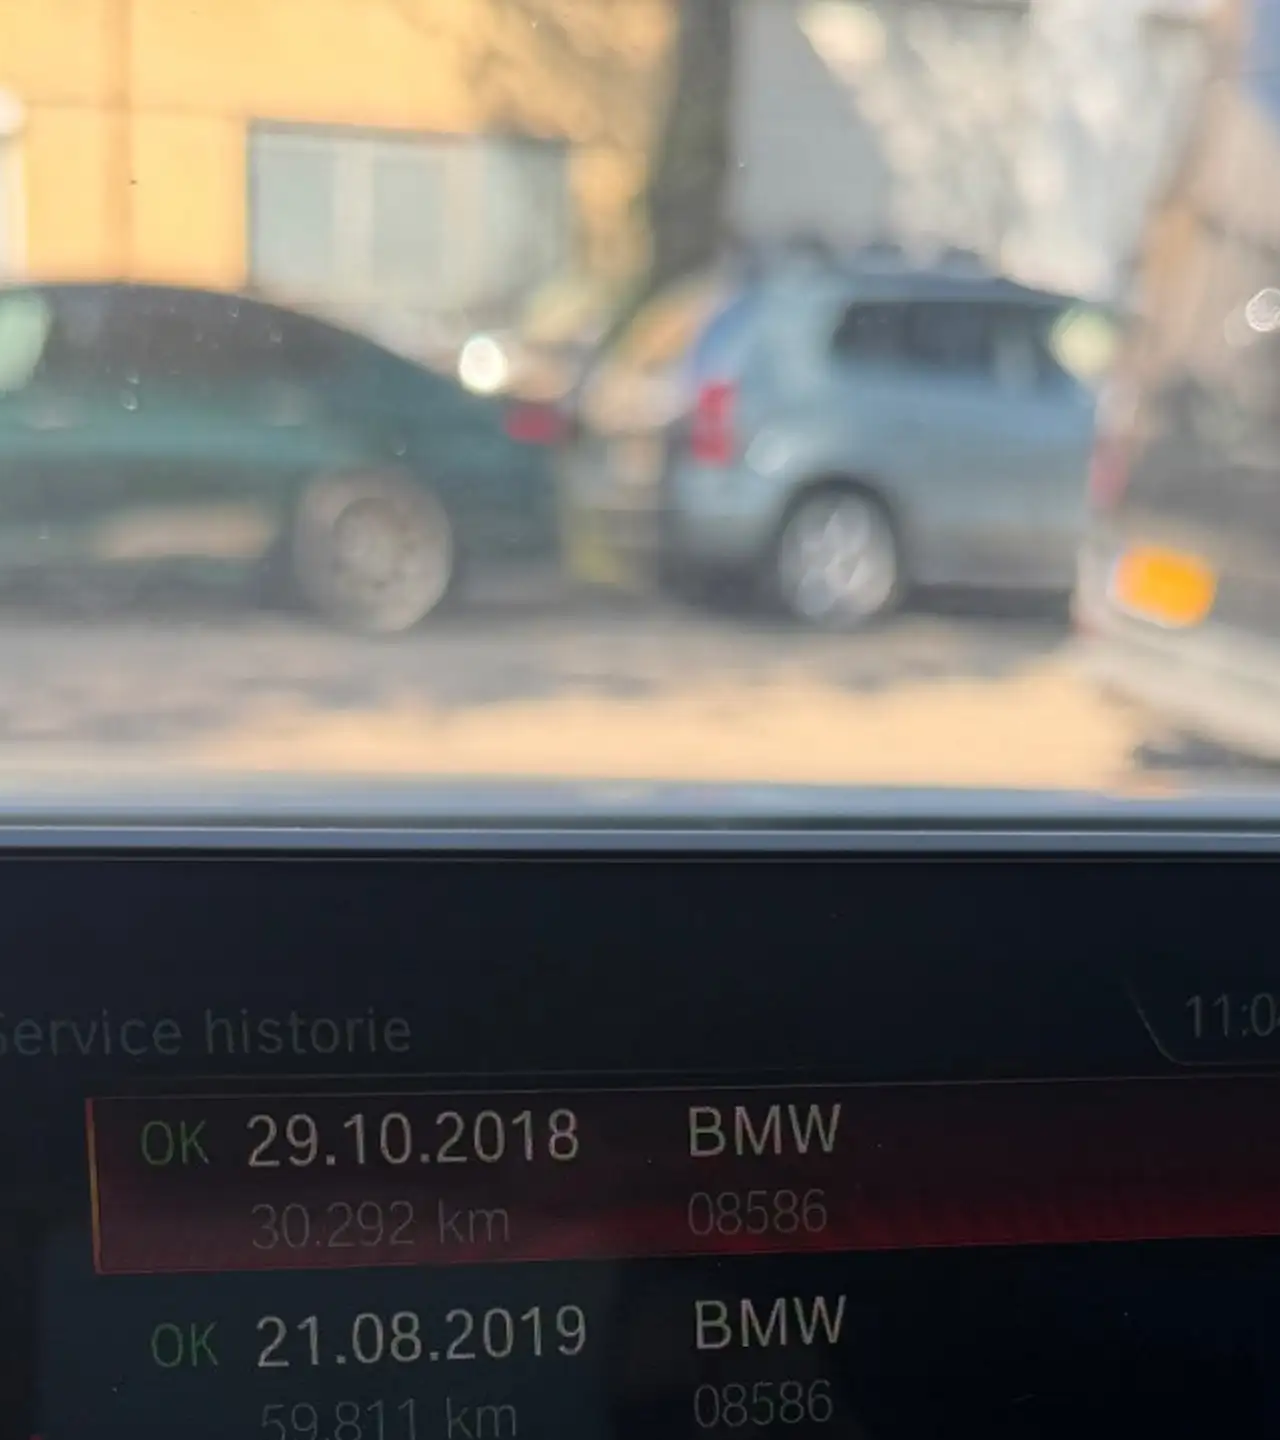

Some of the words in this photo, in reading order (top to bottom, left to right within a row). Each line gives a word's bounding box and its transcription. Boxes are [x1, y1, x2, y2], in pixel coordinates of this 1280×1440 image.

[204, 1005, 412, 1054] historie
[140, 1118, 211, 1167] OK
[245, 1107, 580, 1168] 29.10.2018
[687, 1102, 842, 1159] BMW
[250, 1199, 415, 1250] 30.292
[436, 1197, 511, 1245] km
[686, 1187, 828, 1237] 08586
[149, 1319, 220, 1368] OK
[255, 1303, 587, 1369] 21.08.2019
[693, 1293, 847, 1350] BMW
[444, 1395, 518, 1440] km
[692, 1377, 834, 1429] 08586
